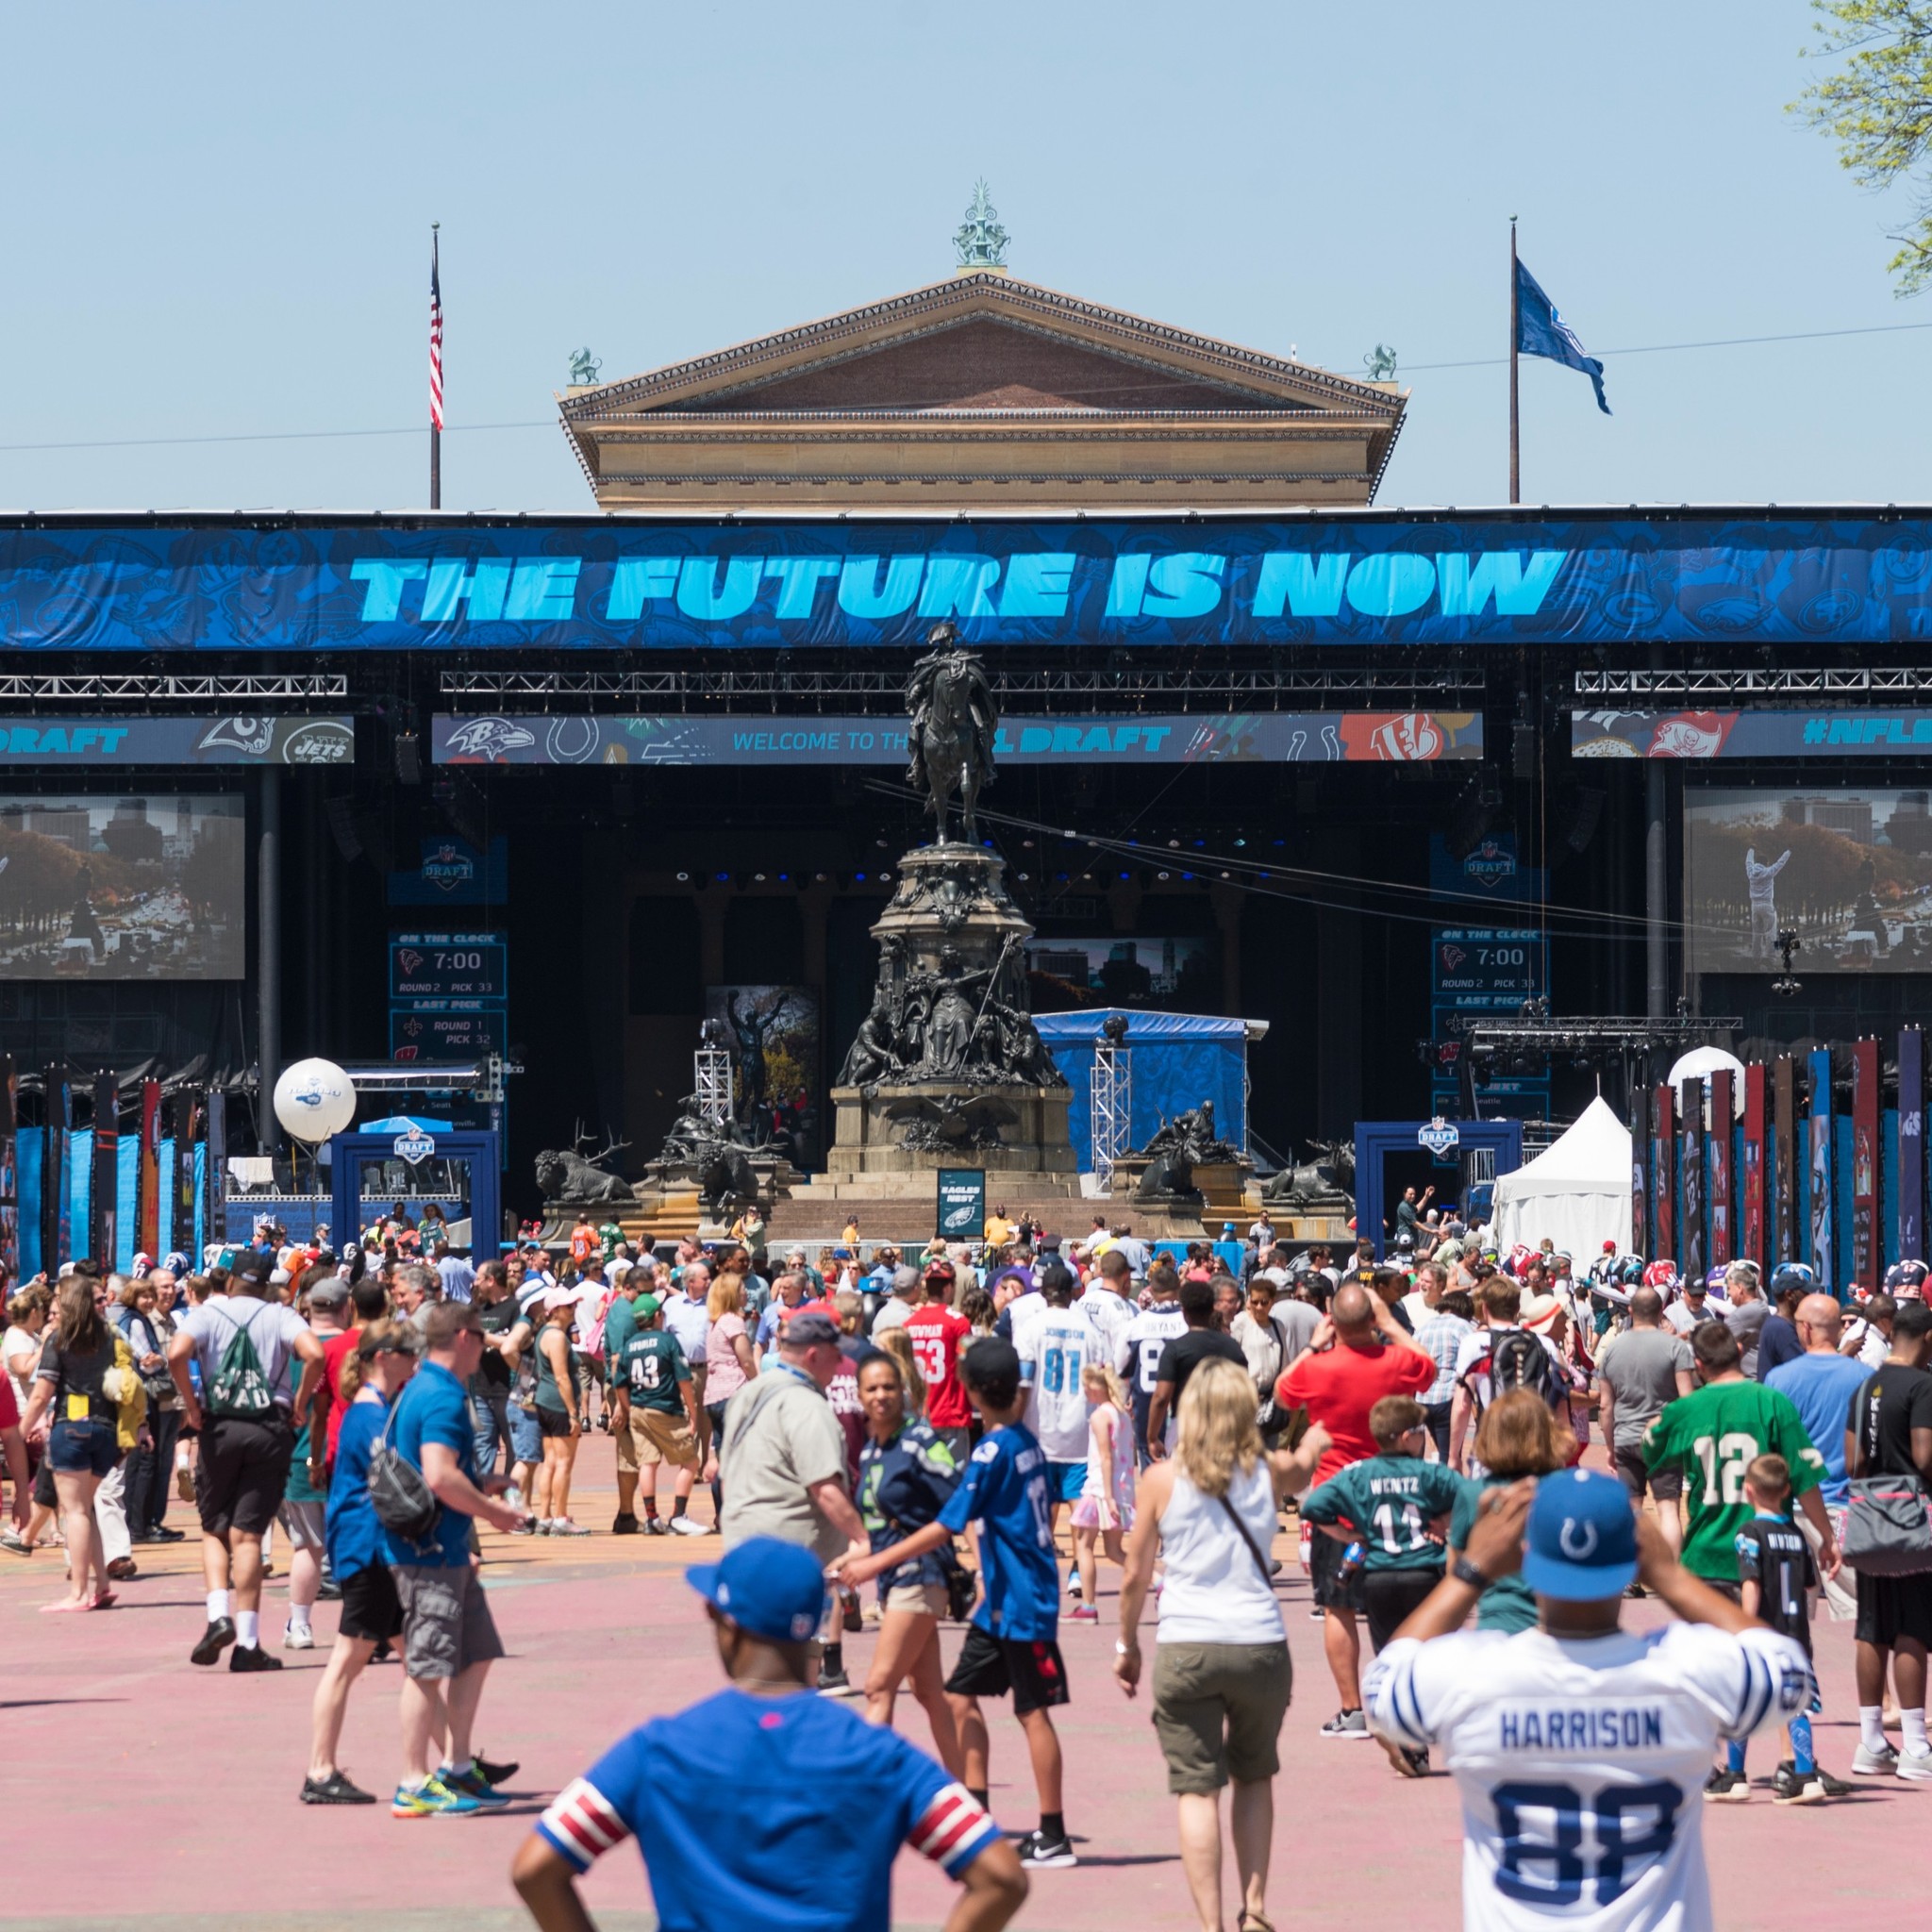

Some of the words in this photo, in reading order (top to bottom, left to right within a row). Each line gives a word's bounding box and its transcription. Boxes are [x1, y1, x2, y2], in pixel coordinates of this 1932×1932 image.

[350, 557, 582, 622] THE
[605, 553, 1076, 621] FUTURE
[1105, 552, 1226, 617] IS
[1252, 551, 1567, 616] NOW
[294, 740, 346, 757] JETS
[733, 732, 841, 751] WELCOME
[848, 732, 874, 750] TO
[881, 732, 909, 750] TH
[1020, 726, 1171, 753] DRAFT
[425, 866, 469, 876] DRAFT
[1468, 862, 1511, 874] DRAFT
[434, 953, 481, 969] 7:00
[1476, 949, 1524, 965] 7:00
[399, 983, 431, 991] ROUND
[433, 983, 441, 991] 2
[451, 983, 473, 991] PICK
[478, 983, 492, 991] 33
[1441, 979, 1474, 988] ROUND
[1476, 979, 1483, 988] 2
[1493, 979, 1515, 988] PICK
[434, 1021, 471, 1030] ROUND
[446, 1035, 470, 1043] PICK
[476, 1035, 491, 1044] 32
[1045, 1326, 1085, 1340] JOHNSON
[912, 1339, 945, 1383] 53
[631, 1355, 659, 1389] 43
[1043, 1348, 1080, 1395] 81
[1693, 1433, 1758, 1506] 12
[1370, 1476, 1419, 1495] WENTZ
[1374, 1503, 1426, 1554] 11
[1500, 1708, 1663, 1750] HARRISON
